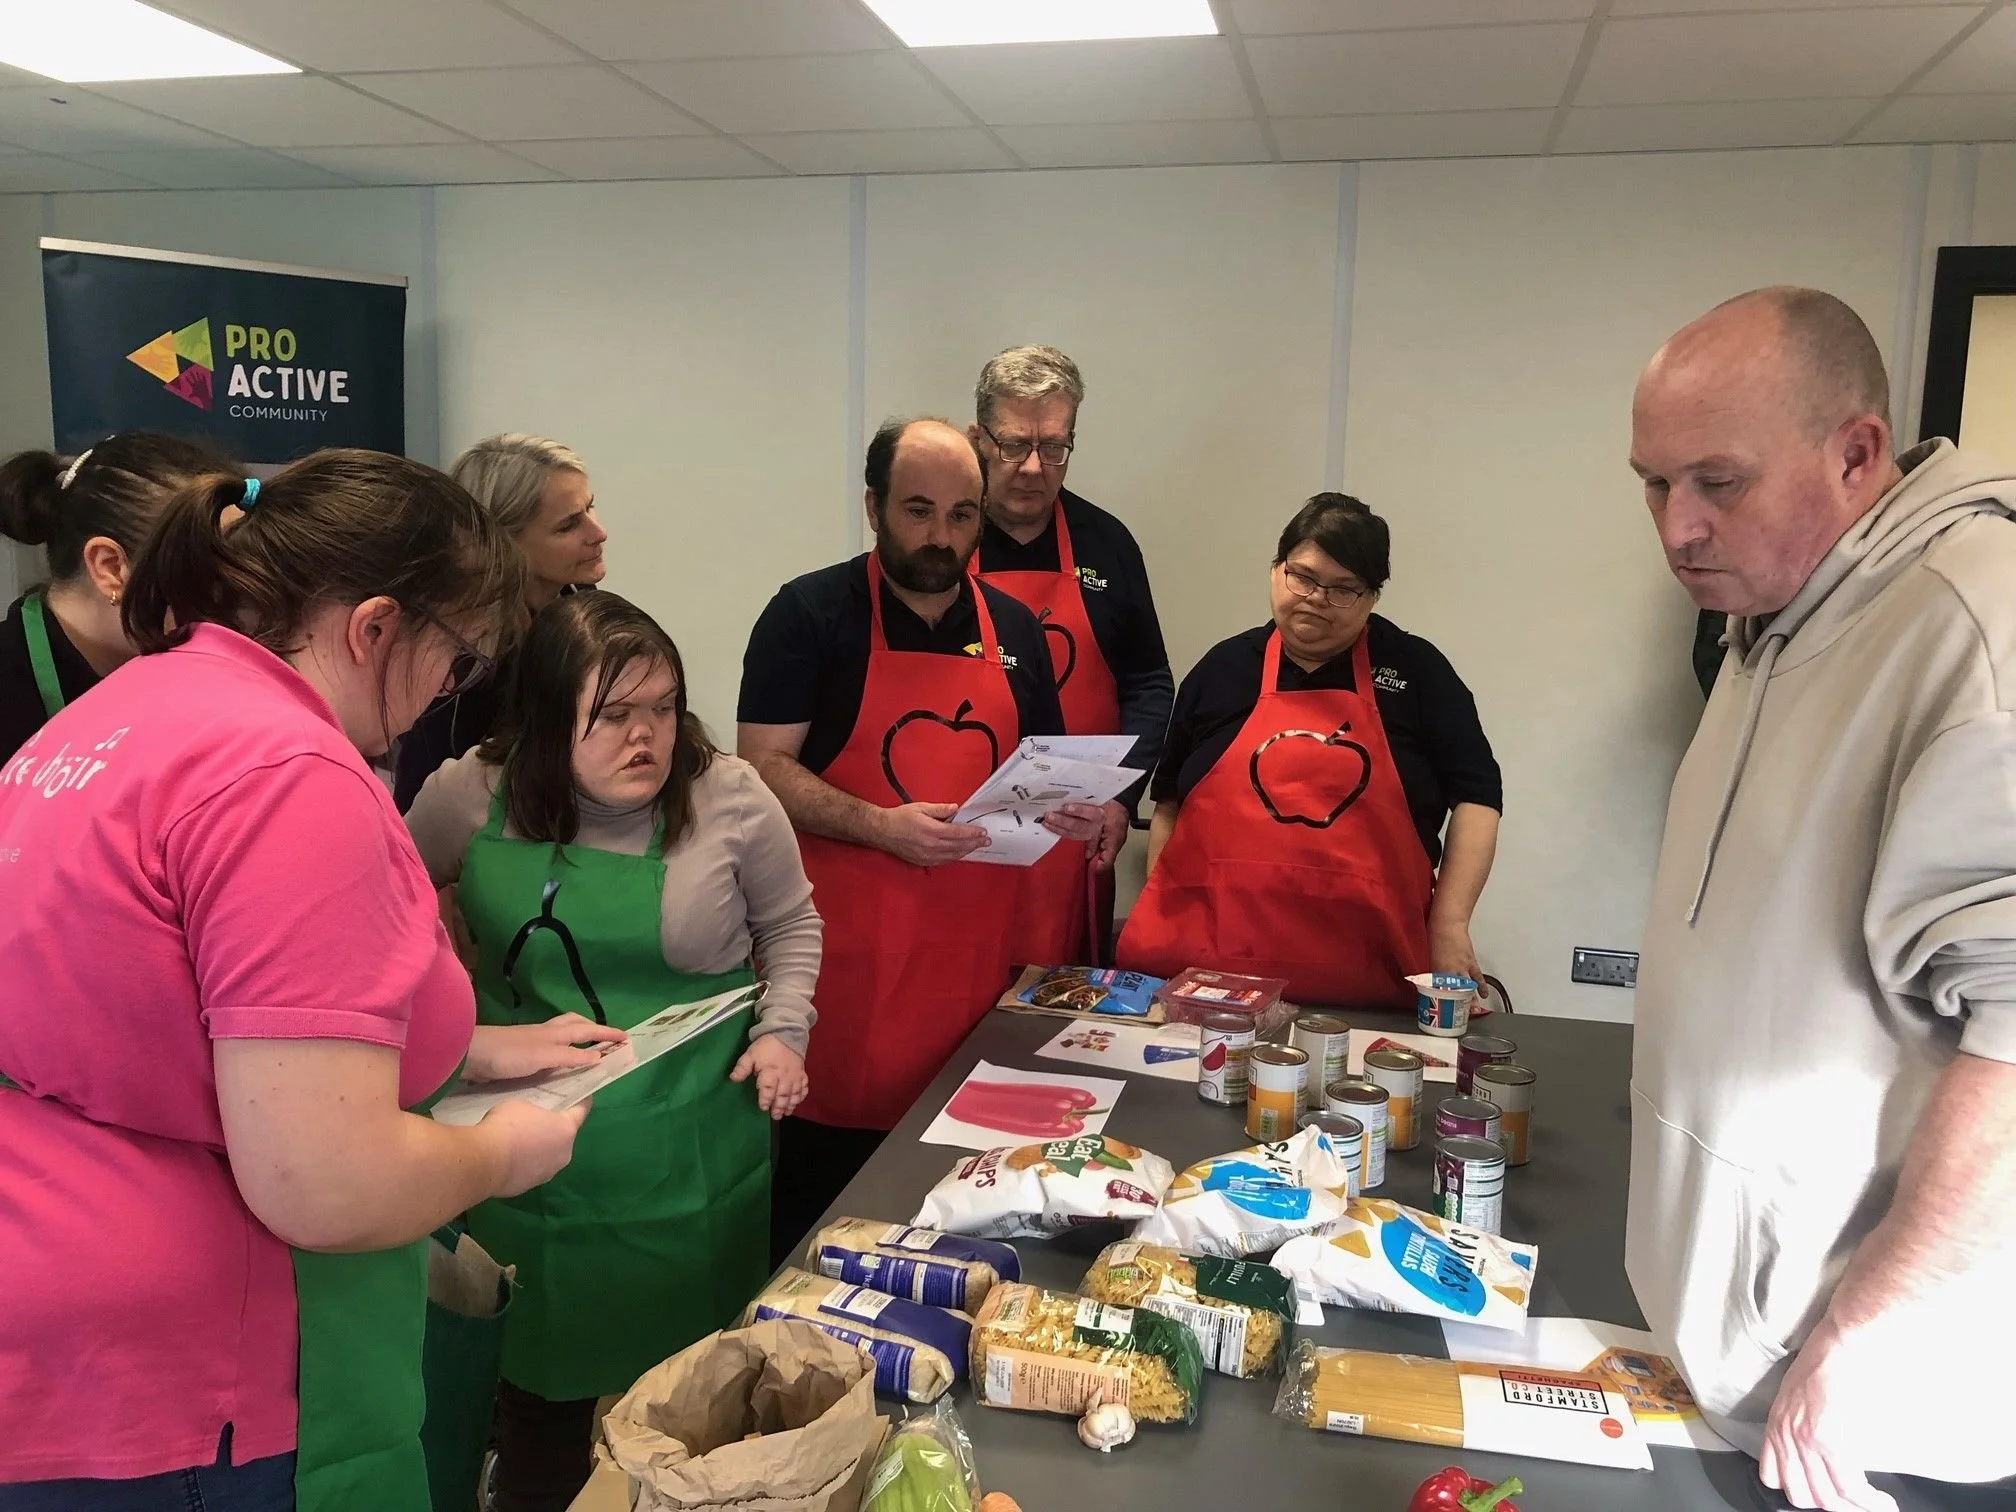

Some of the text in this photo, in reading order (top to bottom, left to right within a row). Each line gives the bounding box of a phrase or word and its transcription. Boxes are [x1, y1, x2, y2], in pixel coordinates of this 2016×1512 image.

[225, 324, 297, 362] PRO
[227, 363, 350, 404] ACTIVE
[229, 404, 329, 422] COMMUNITY
[1081, 567, 1097, 578] PRO
[1083, 574, 1108, 588] ACTIVE
[998, 654, 1018, 667] TIVE
[1374, 674, 1408, 690] ACTIVE
[1378, 667, 1398, 679] PRO
[1044, 1140, 1072, 1162] eal
[1069, 1136, 1104, 1162] Eat
[1438, 1228, 1480, 1293] SAVERS
[1225, 1261, 1248, 1286] FUSILLI
[1518, 1375, 1582, 1386] SPAGHETTI
[1506, 1381, 1597, 1400] STREET CO.
[1513, 1391, 1599, 1410] STAMFORD
